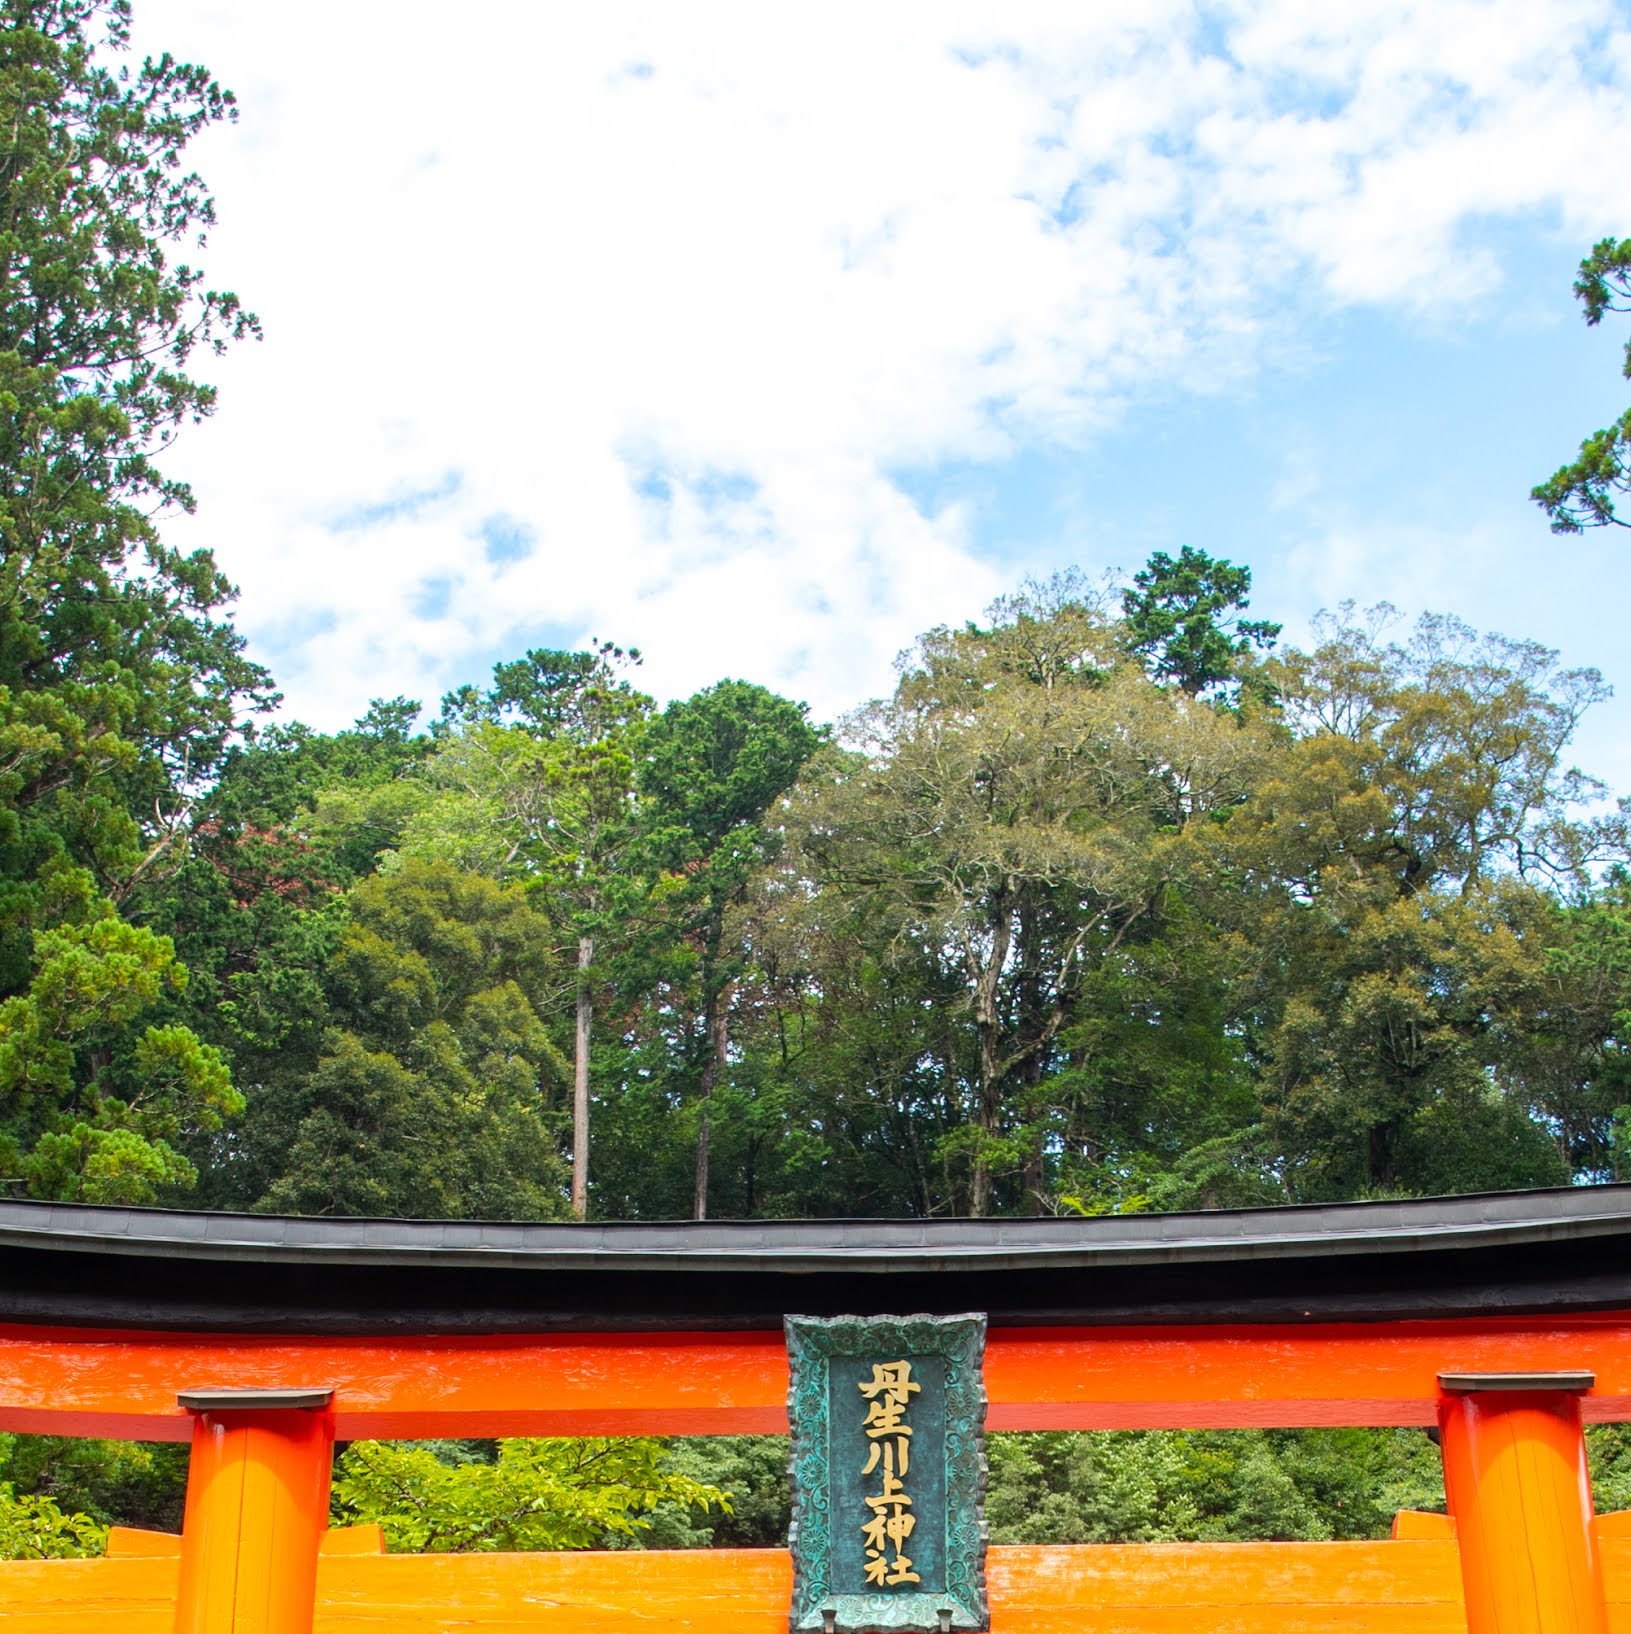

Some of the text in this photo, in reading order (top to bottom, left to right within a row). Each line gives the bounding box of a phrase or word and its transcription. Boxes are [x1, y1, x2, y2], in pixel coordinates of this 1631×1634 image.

[858, 1359, 921, 1587] 丹生川上神社
